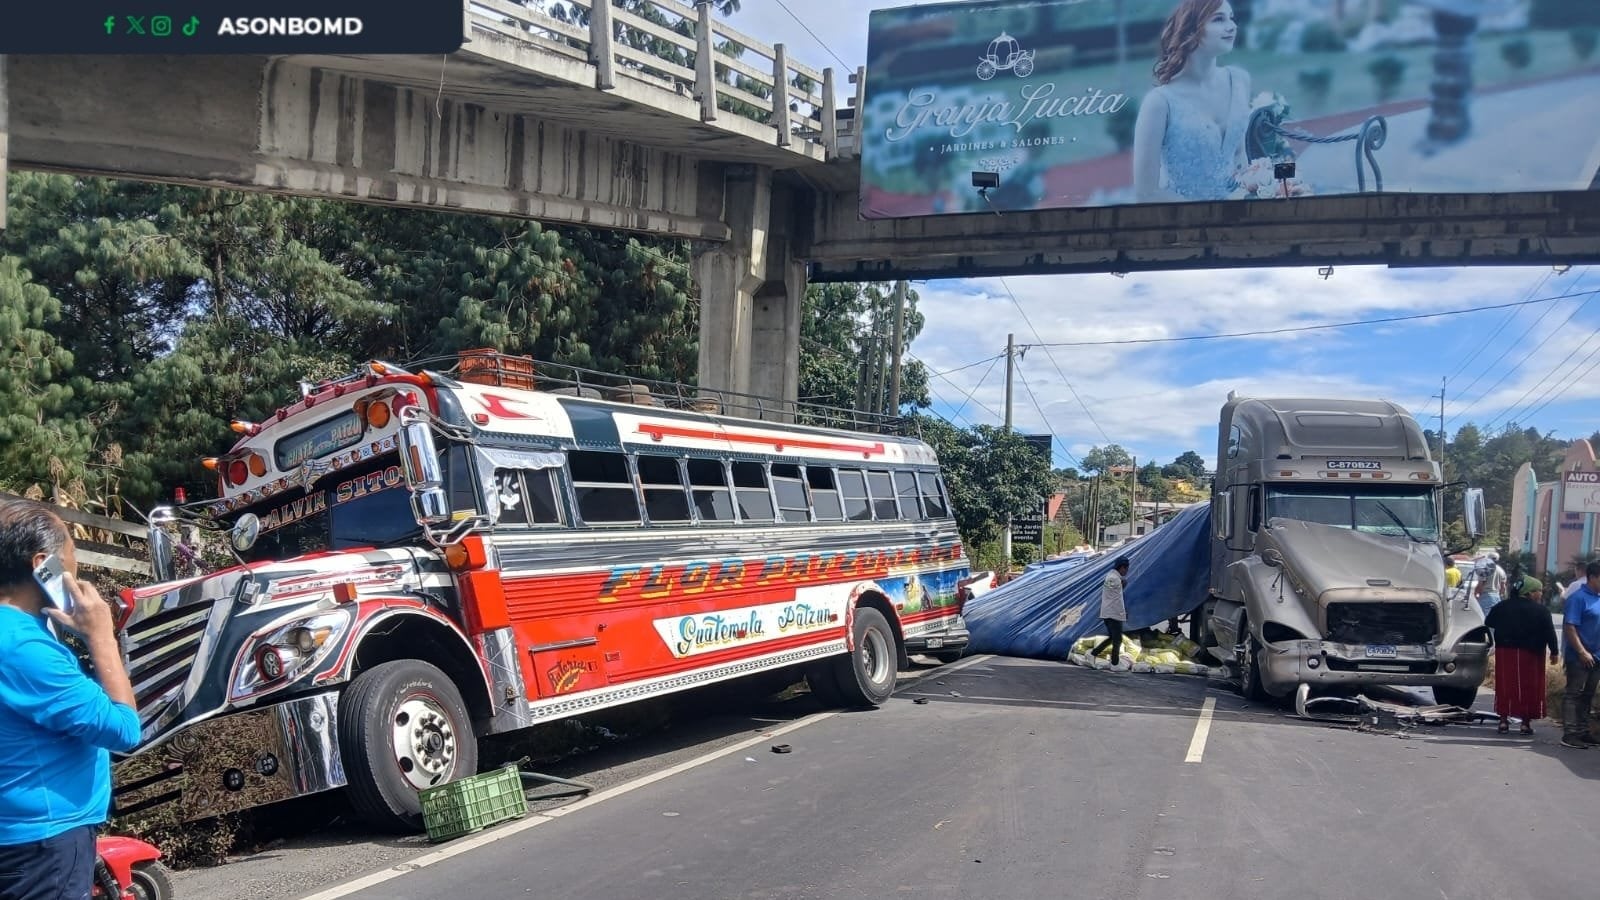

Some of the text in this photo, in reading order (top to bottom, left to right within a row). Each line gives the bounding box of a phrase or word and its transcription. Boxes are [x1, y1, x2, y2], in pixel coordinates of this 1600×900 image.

[886, 82, 1128, 142] Granja Lucita
[940, 141, 995, 155] JARDINES
[1011, 136, 1066, 149] SALONES
[1327, 461, 1380, 469] C-870BZX
[1567, 473, 1598, 482] AUTO
[336, 465, 401, 503] SITO
[598, 557, 747, 603] FLOR
